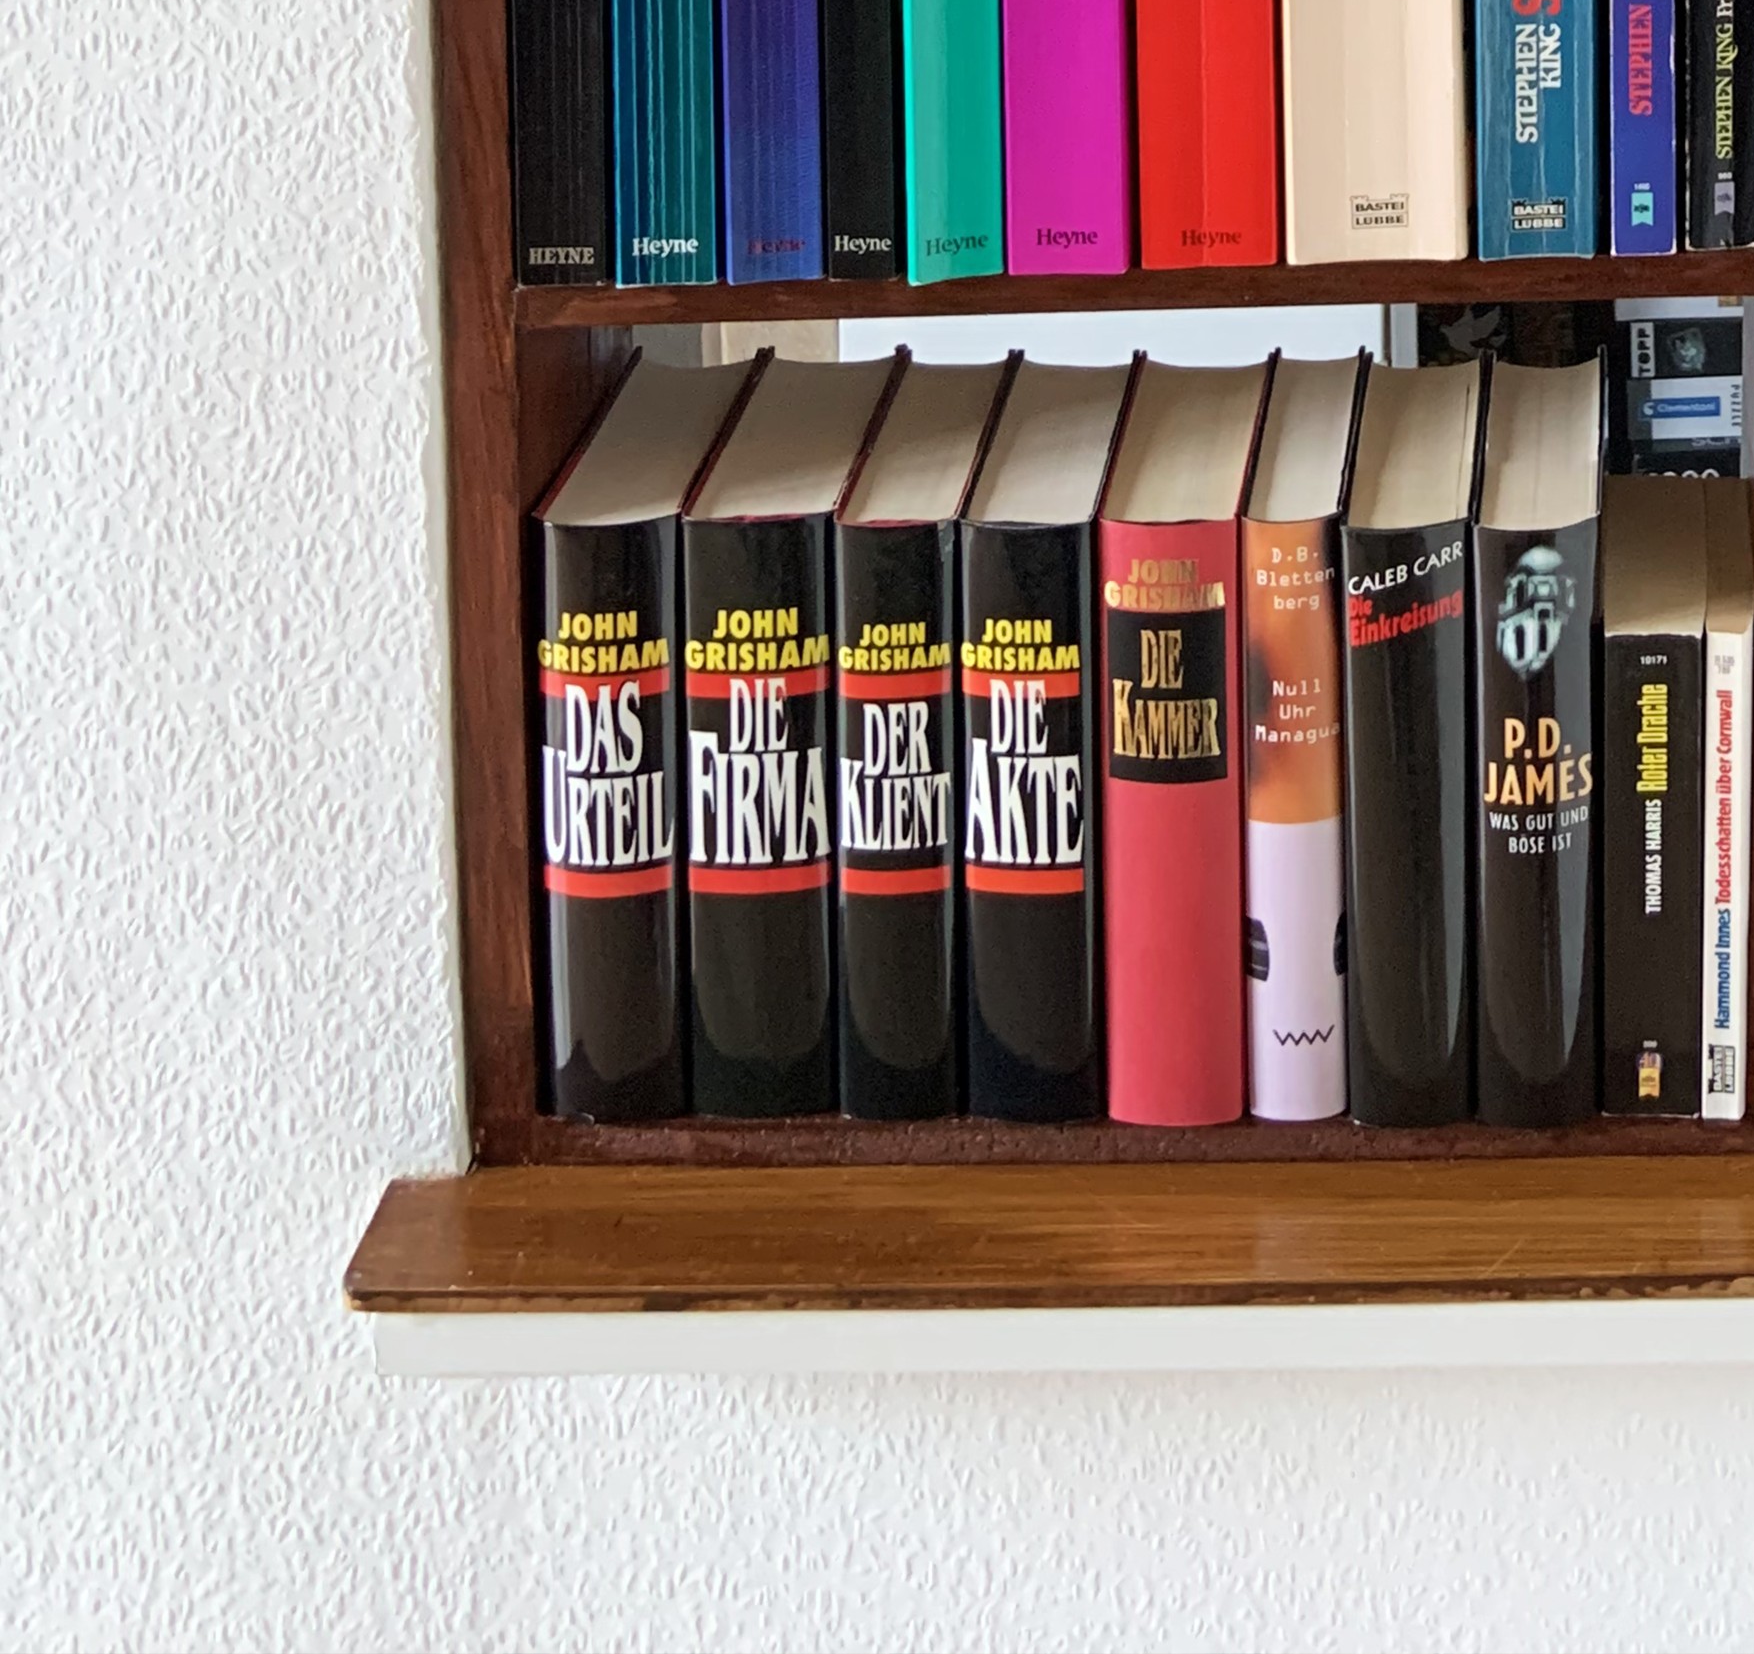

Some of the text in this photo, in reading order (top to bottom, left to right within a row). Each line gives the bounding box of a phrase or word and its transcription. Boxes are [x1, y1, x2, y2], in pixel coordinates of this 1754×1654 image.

[1354, 200, 1405, 213] BASTEI
[632, 235, 699, 258] Heyne
[1637, 326, 1651, 374] TOPP
[1348, 541, 1463, 596] CALEB CARR
[558, 610, 637, 640] JOHN
[1350, 592, 1463, 647] Einkreisung
[538, 638, 670, 672] GRISHAM
[565, 681, 641, 775] DAS
[544, 745, 673, 865] URTEIL
[1637, 683, 1667, 914] THOMAS HARRIS Roter Drache
